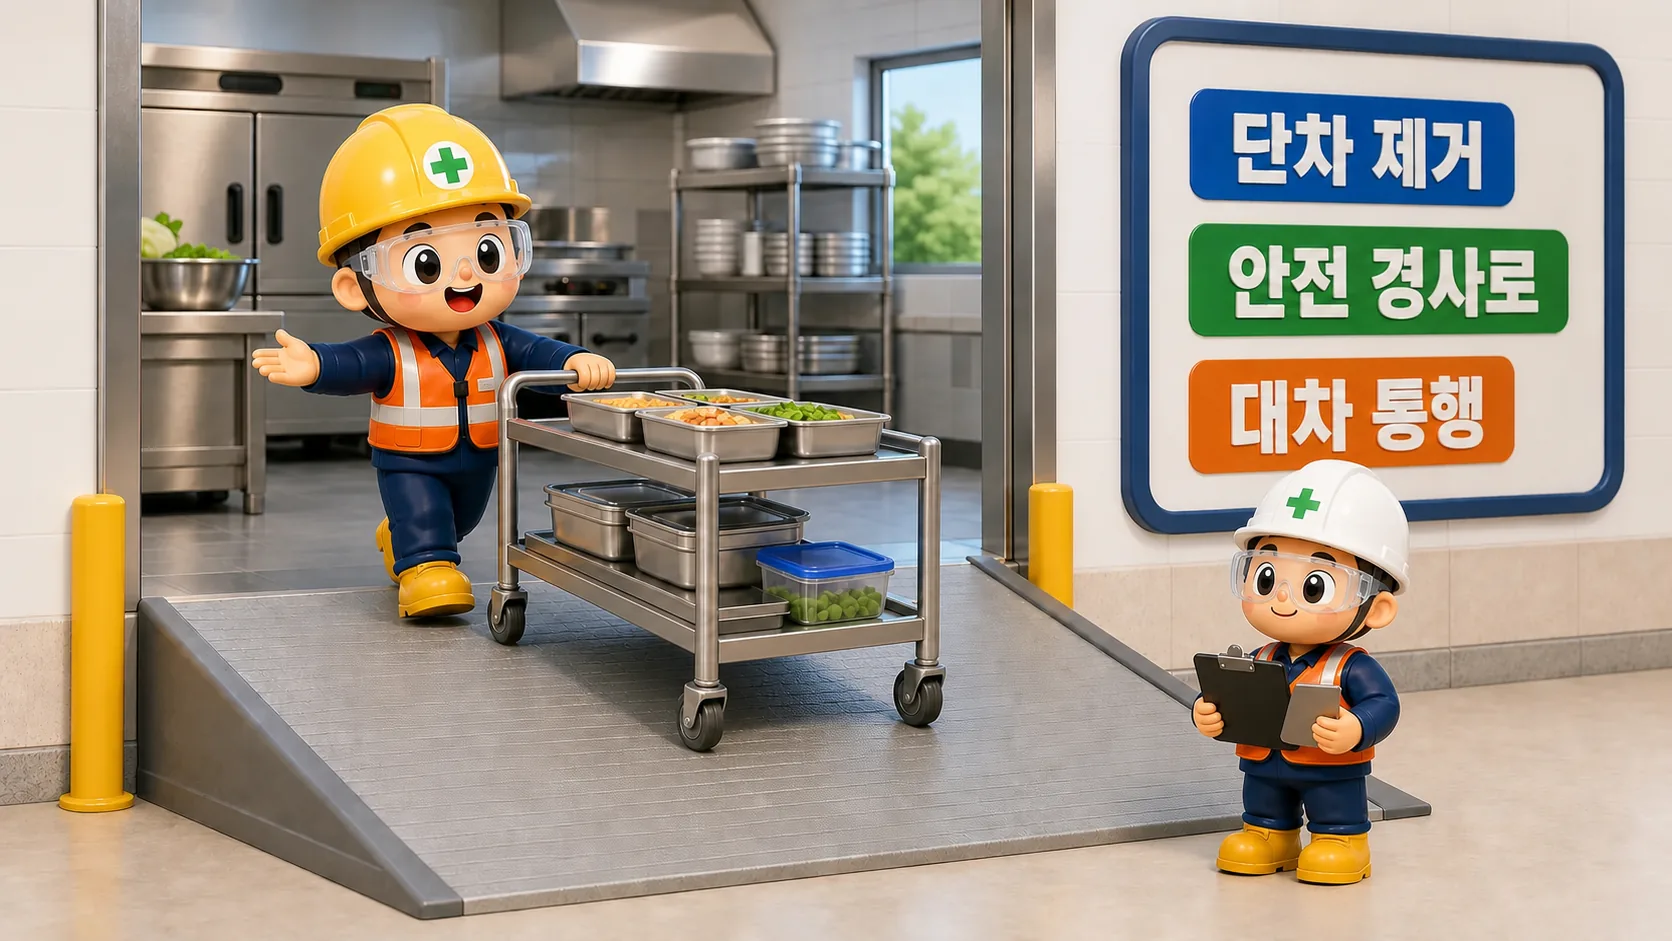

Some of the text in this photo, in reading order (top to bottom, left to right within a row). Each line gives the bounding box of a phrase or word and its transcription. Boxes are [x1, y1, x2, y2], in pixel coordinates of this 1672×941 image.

[1232, 111, 1483, 190] 단차 제거
[1228, 245, 1539, 320] 안전 경사로
[1230, 375, 1485, 454] 대차 통행
